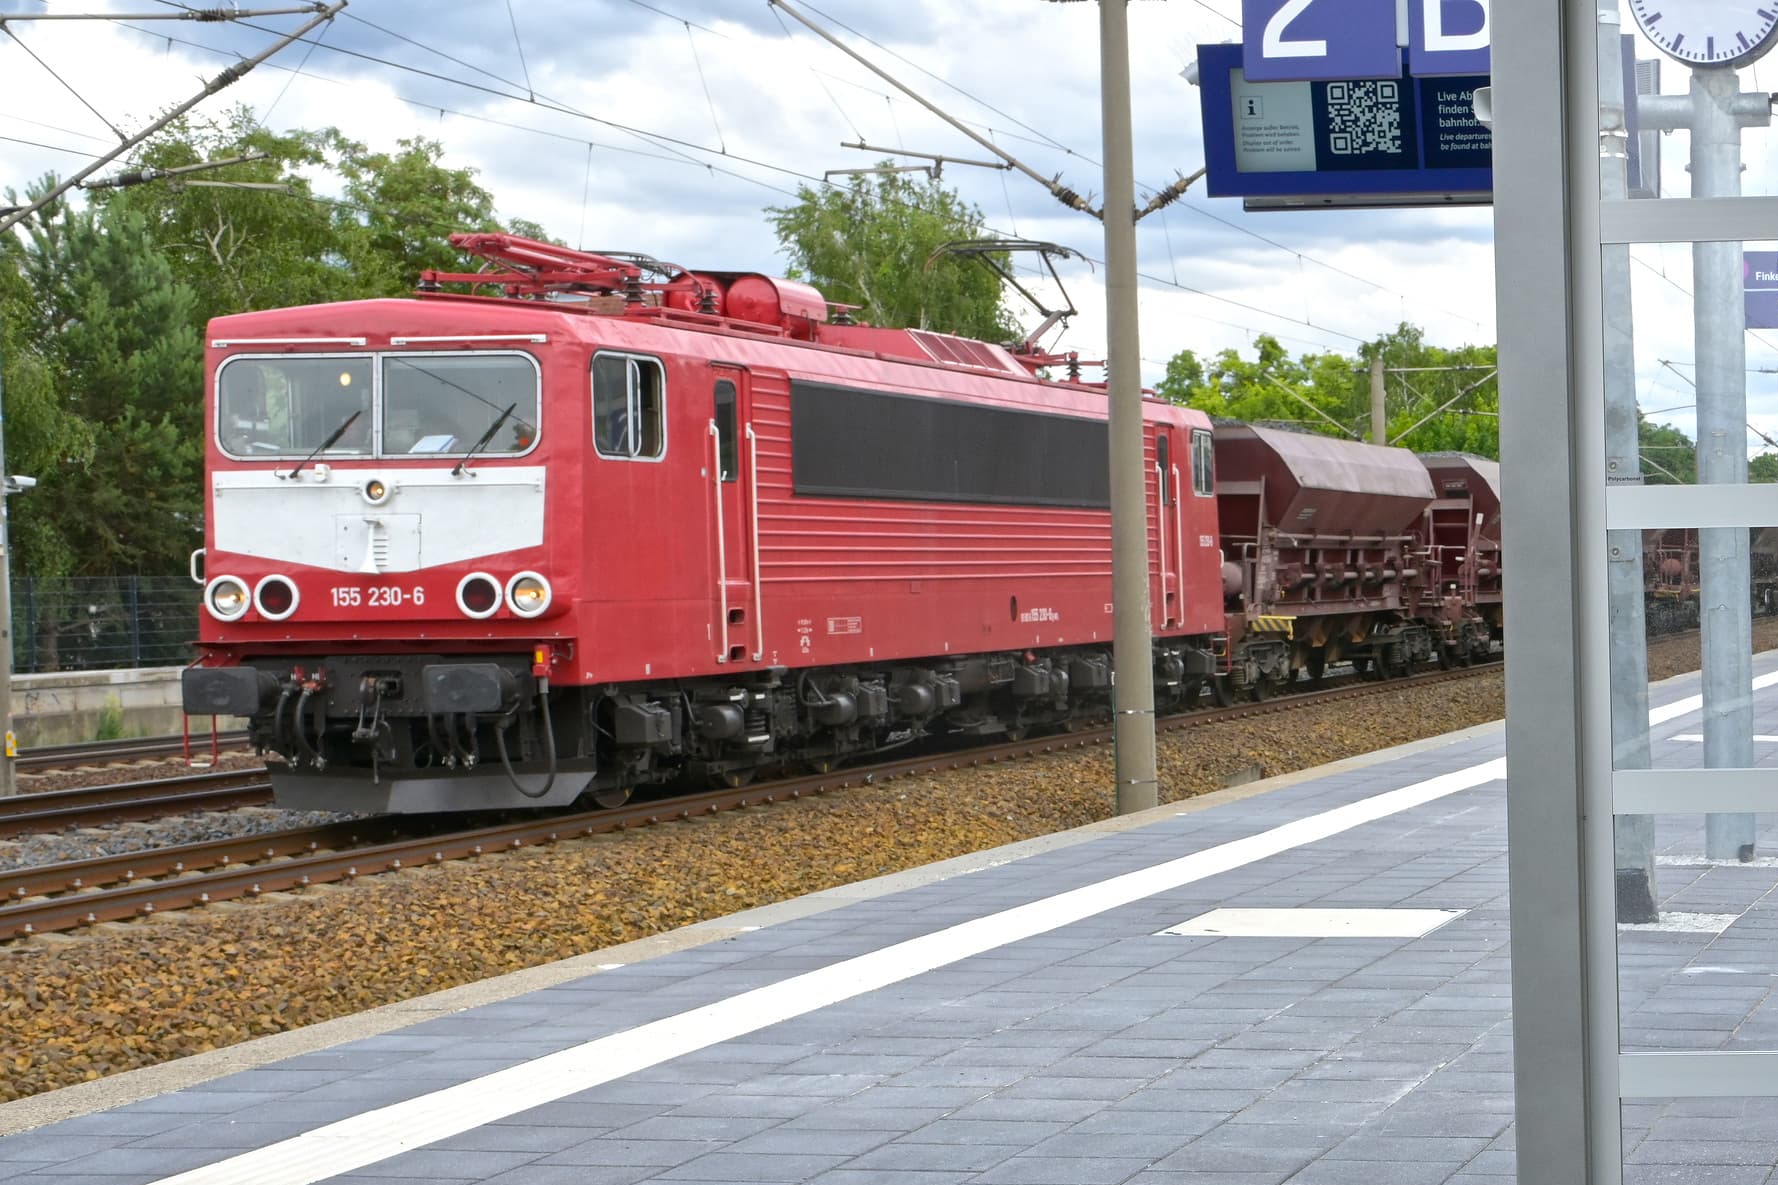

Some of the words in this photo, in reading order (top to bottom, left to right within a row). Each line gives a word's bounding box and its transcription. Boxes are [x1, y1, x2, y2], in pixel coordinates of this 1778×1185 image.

[1437, 91, 1457, 101] Live
[1459, 91, 1473, 101] Ab
[1438, 104, 1469, 114] finden
[1440, 132, 1455, 141] Live
[1450, 143, 1471, 152] found
[330, 586, 361, 607] 155
[367, 585, 425, 607] 230-6
